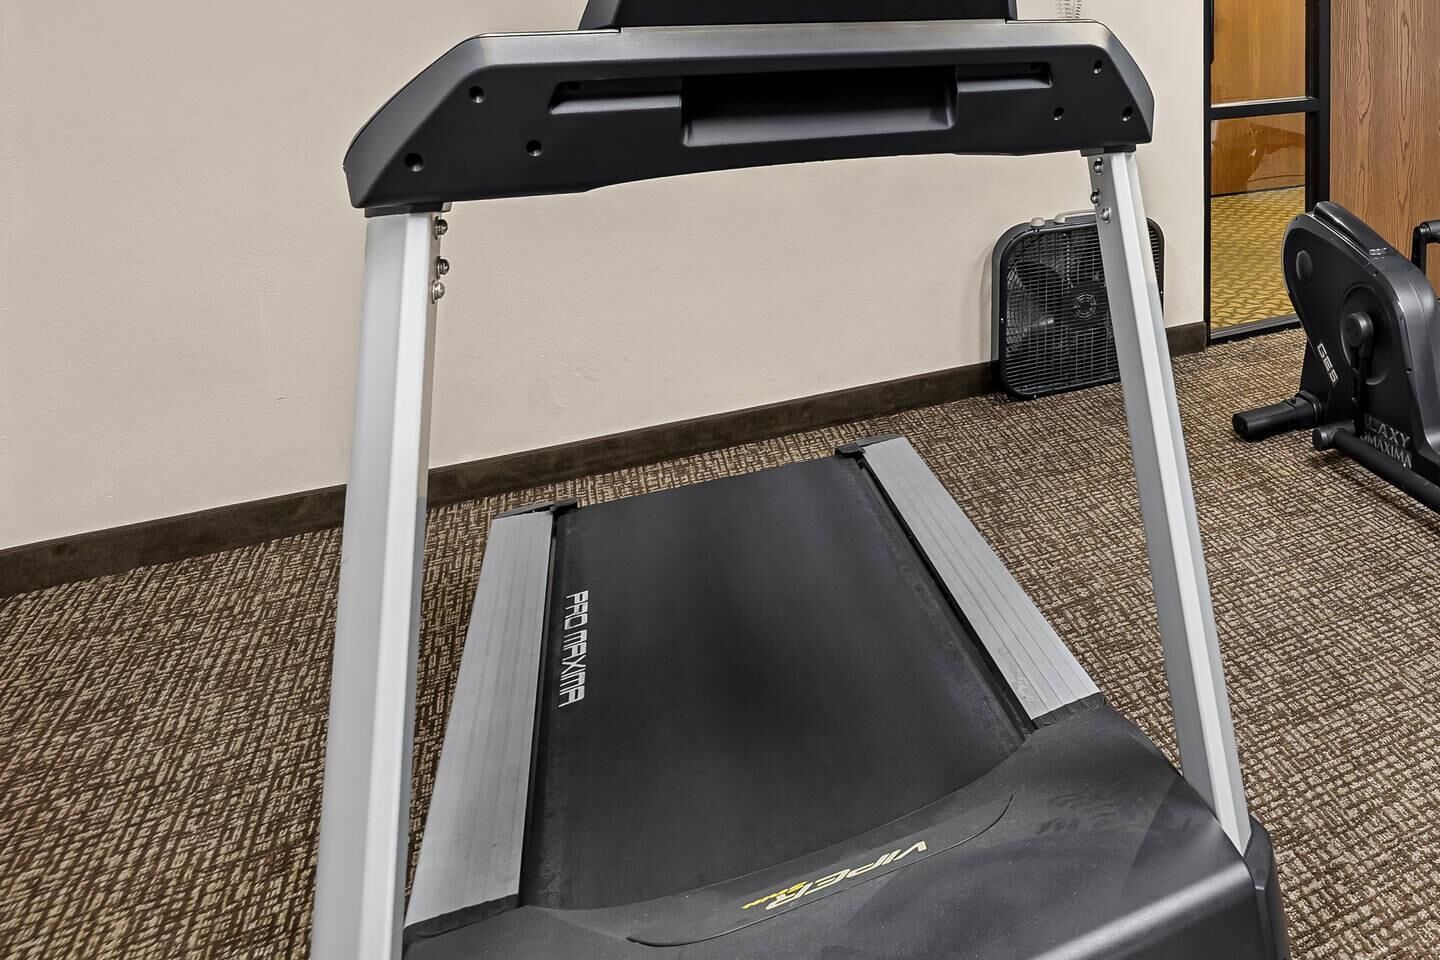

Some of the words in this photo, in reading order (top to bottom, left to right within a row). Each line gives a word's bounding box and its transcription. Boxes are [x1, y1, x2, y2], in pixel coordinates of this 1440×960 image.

[1366, 415, 1411, 448] LAXY
[564, 590, 589, 630] PRO
[558, 629, 588, 708] MAXIMA
[765, 840, 927, 910] VIPER
